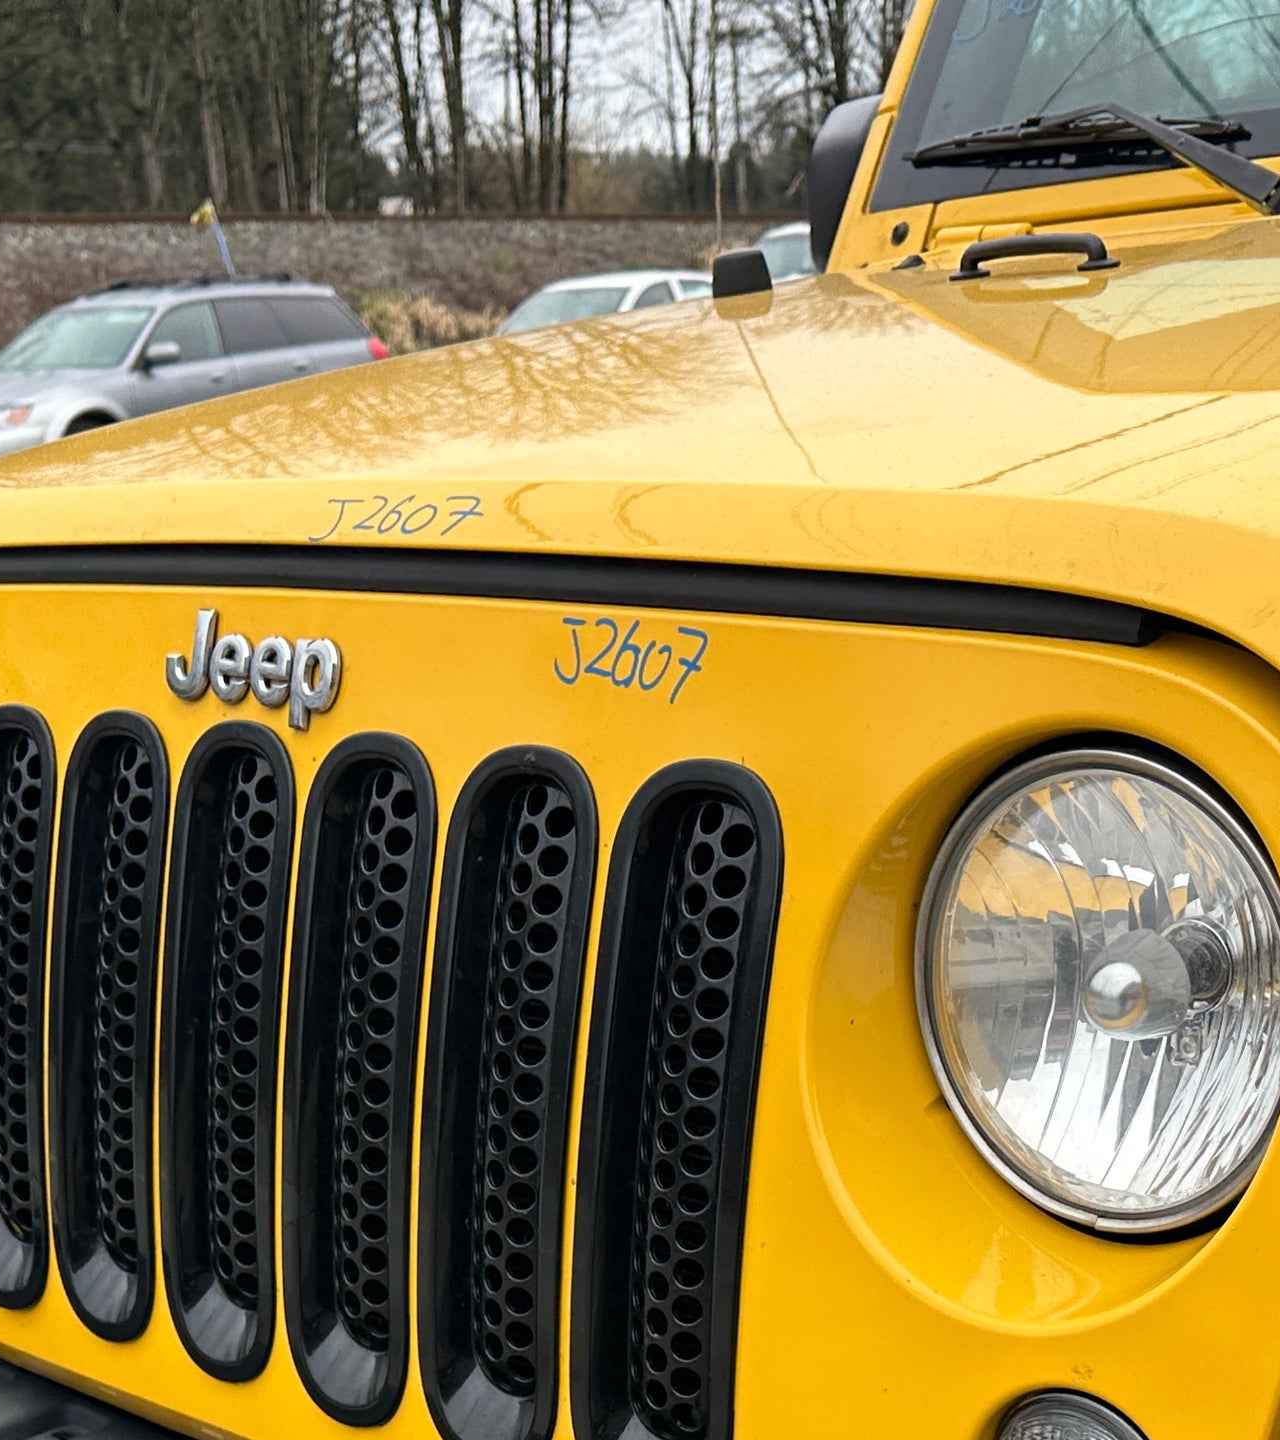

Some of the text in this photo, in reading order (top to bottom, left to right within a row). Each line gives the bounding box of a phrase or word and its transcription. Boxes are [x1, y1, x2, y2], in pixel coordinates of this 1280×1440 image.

[308, 495, 483, 542] J2607
[165, 608, 342, 731] Jeep
[554, 617, 709, 704] J2607
